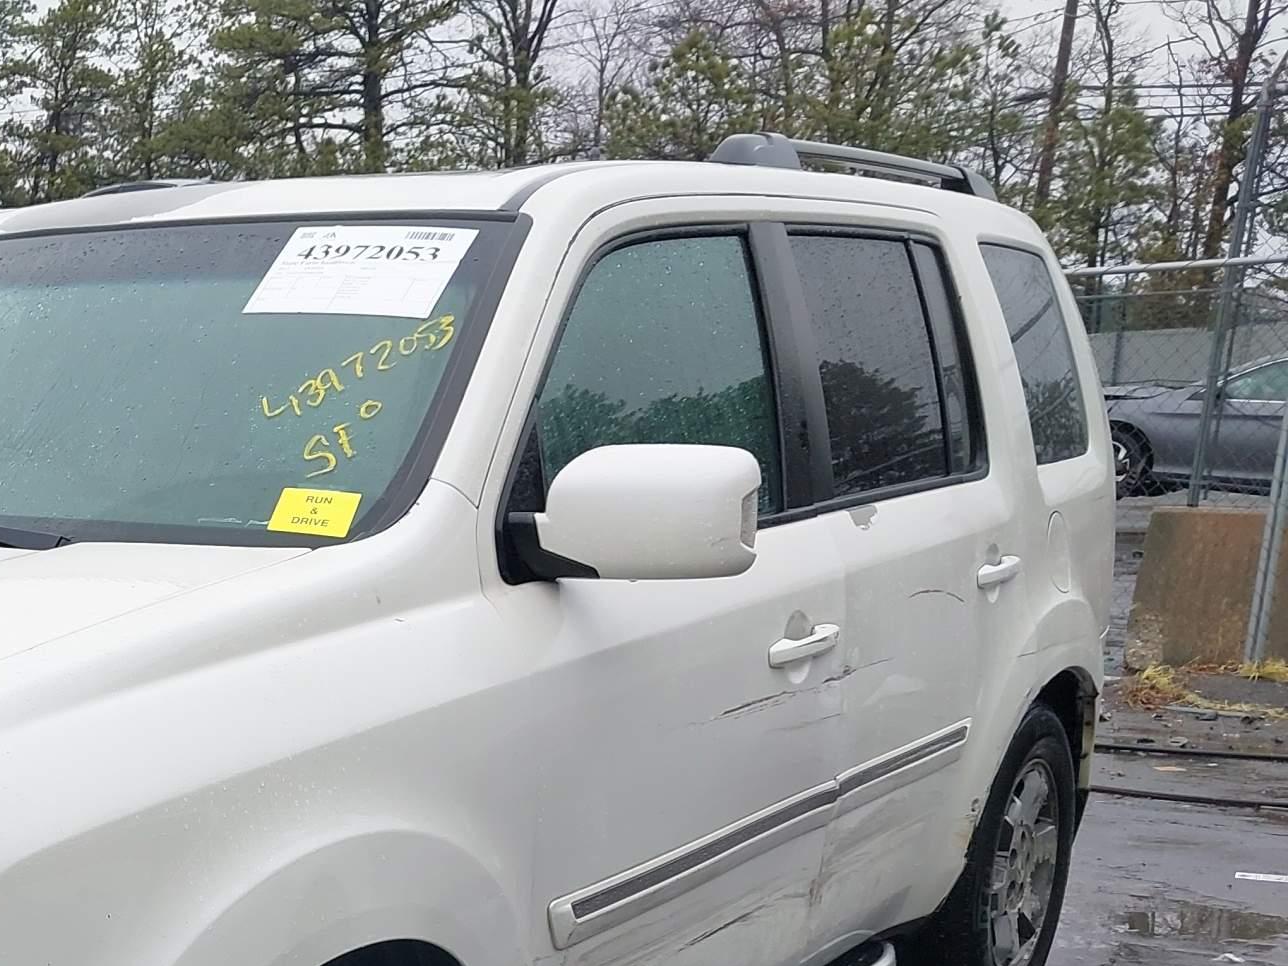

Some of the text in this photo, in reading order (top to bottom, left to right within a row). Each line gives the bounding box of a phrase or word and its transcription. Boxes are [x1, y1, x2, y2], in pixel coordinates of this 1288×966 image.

[297, 244, 441, 261] 43972053
[261, 314, 455, 417] 43972053
[305, 495, 334, 505] RUN
[310, 507, 319, 515] &
[290, 516, 331, 527] DRIVE
